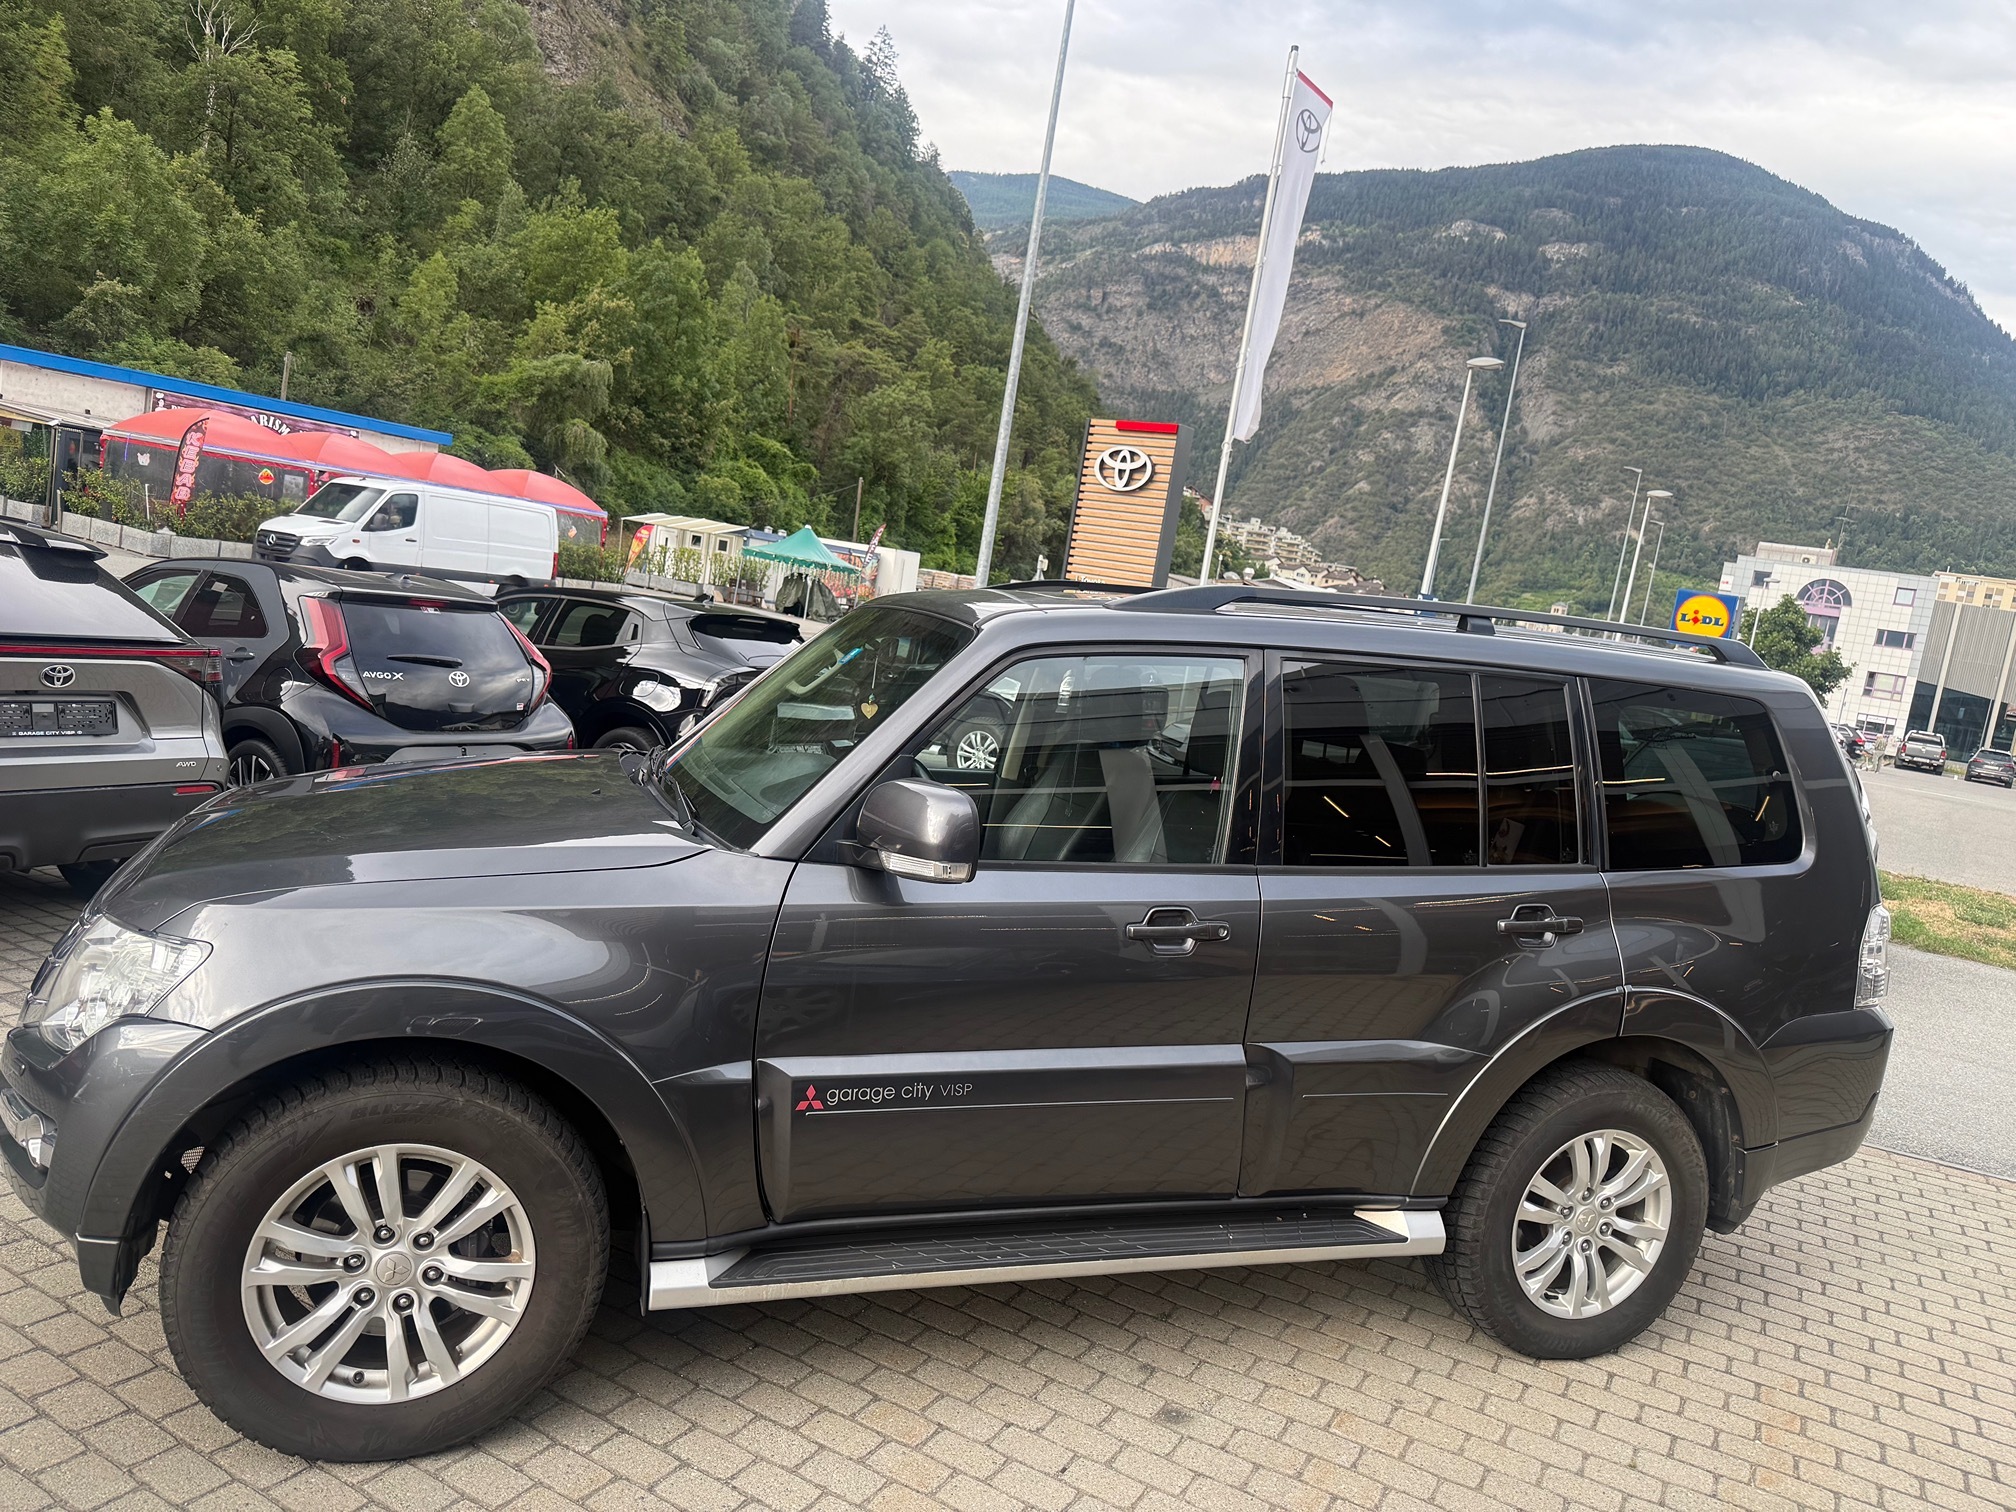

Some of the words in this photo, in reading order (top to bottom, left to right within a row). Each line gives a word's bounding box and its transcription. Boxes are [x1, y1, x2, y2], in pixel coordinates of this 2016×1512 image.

[174, 431, 204, 500] KEBAB
[392, 671, 404, 681] X
[826, 1085, 896, 1106] garage
[901, 1081, 935, 1101] city
[939, 1082, 974, 1097] VISP
